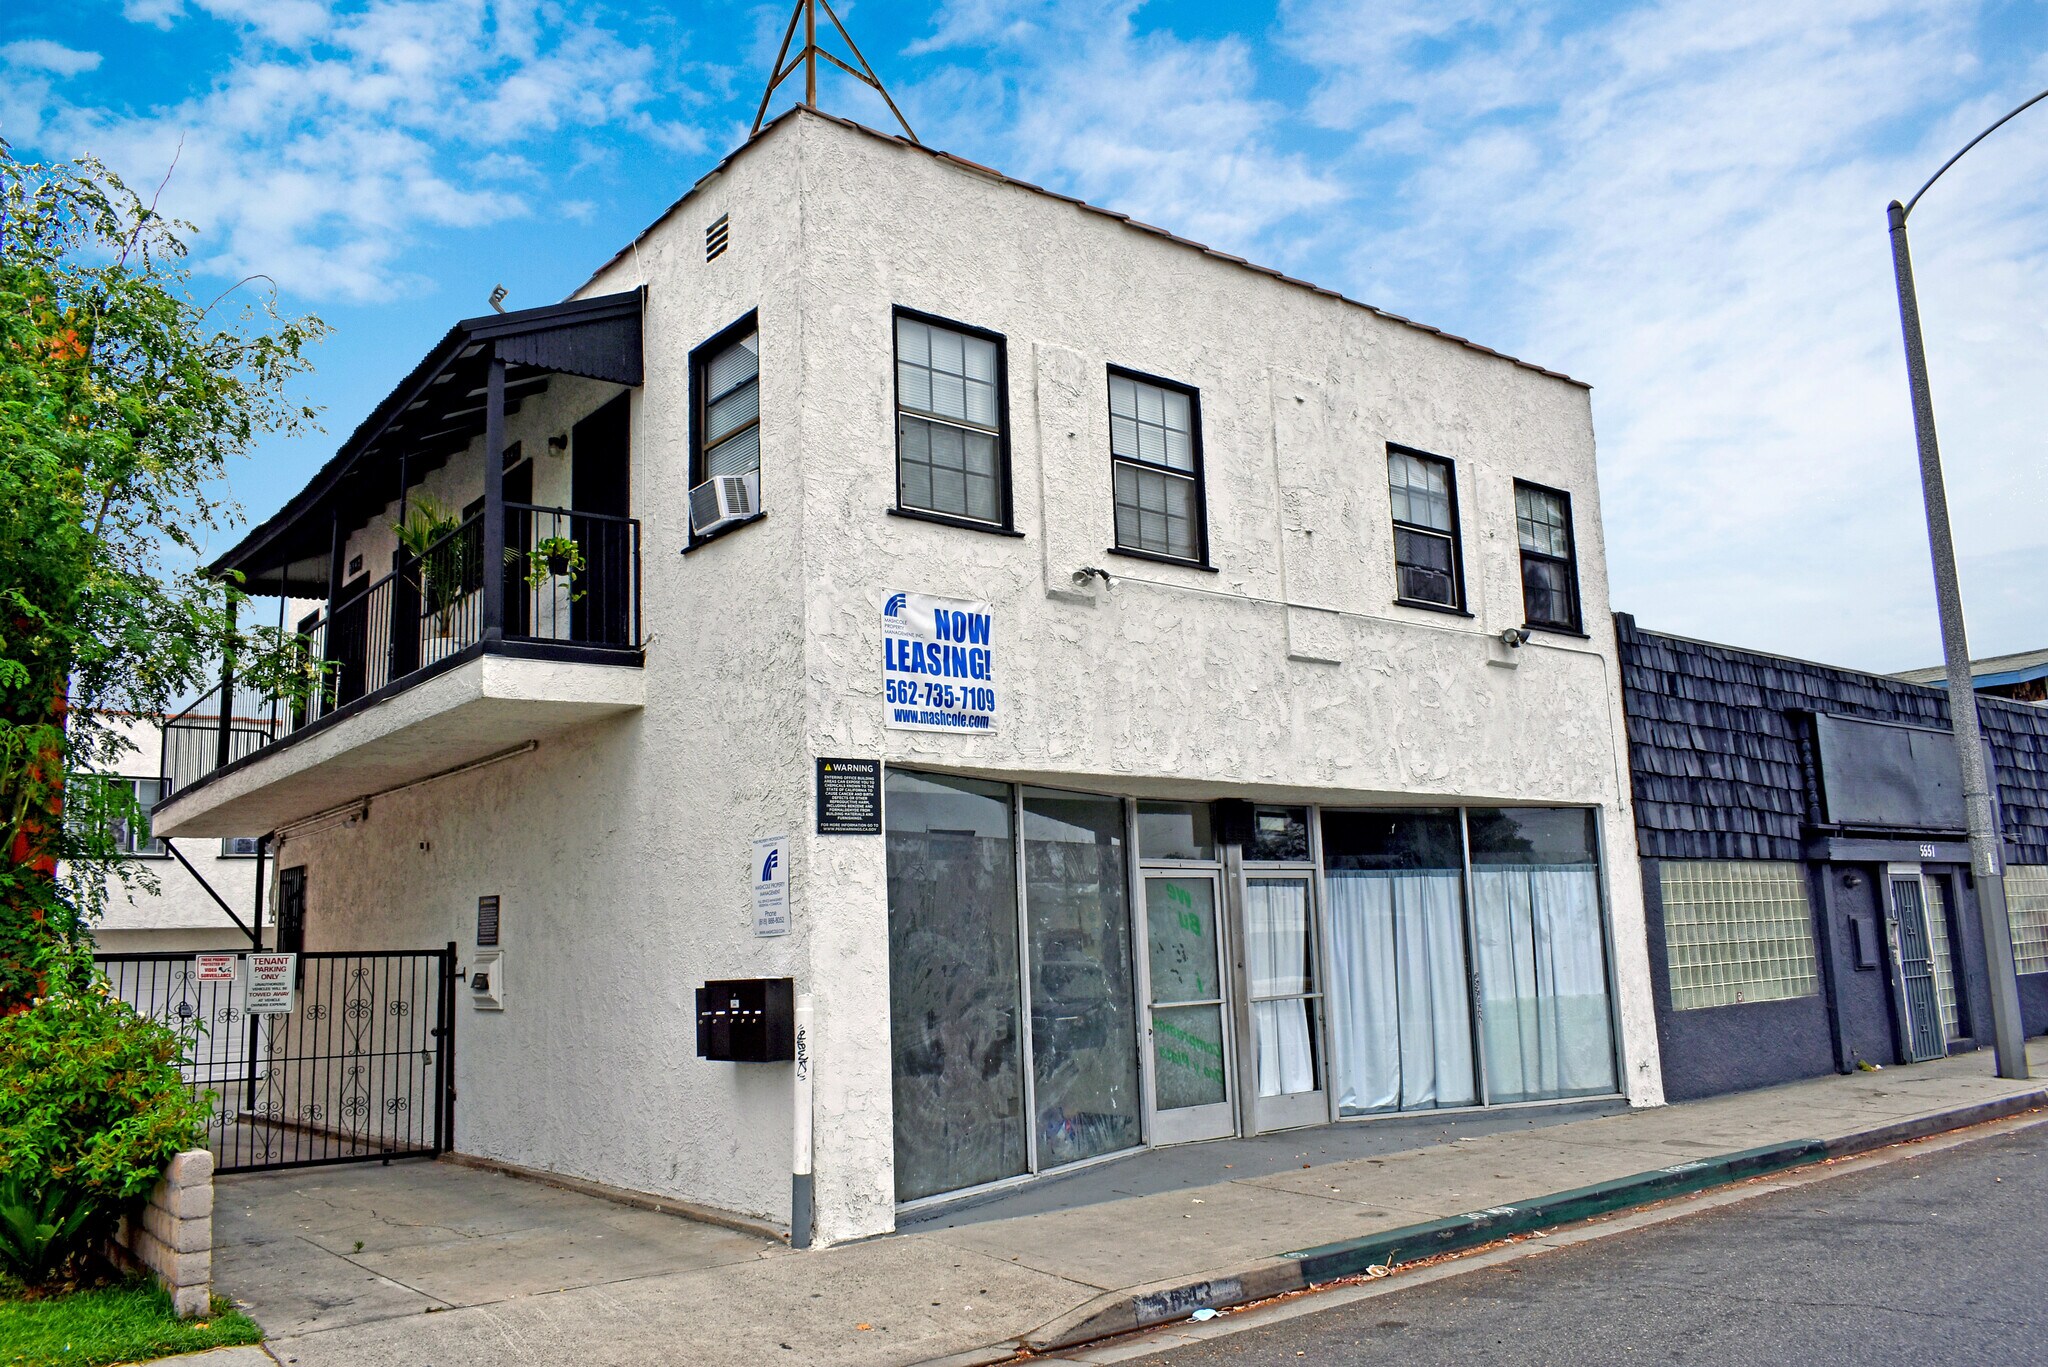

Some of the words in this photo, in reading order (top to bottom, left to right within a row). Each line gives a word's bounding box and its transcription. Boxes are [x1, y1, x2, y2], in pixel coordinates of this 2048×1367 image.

[884, 618, 908, 626] MASHCOLE
[934, 608, 991, 646] NOW
[885, 638, 992, 681] LEASING!
[886, 679, 995, 712] 562-735-7109
[894, 709, 989, 728] www.mashcole.com
[833, 764, 874, 773] WARNING
